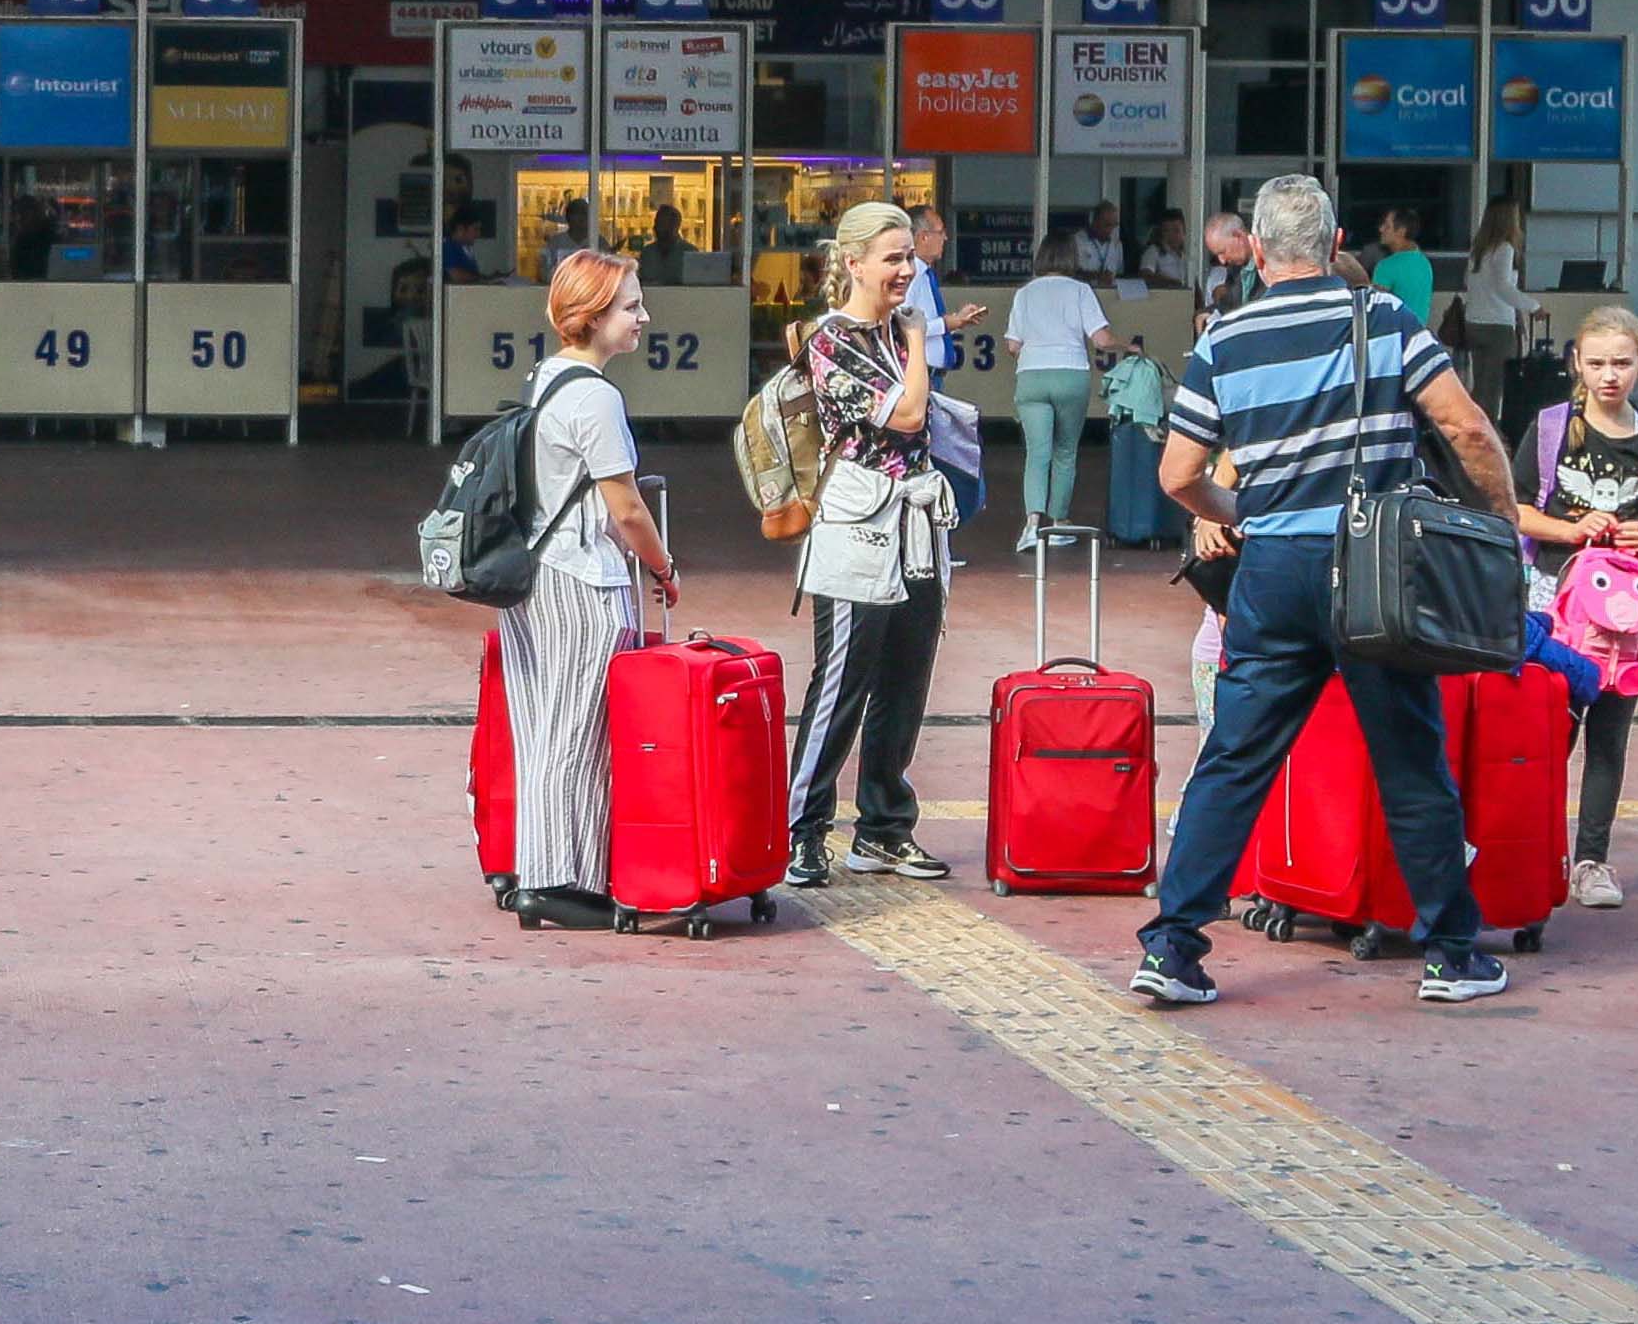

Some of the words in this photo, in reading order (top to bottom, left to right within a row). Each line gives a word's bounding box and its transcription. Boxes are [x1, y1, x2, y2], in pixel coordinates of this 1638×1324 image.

[480, 41, 532, 55] vtours
[34, 78, 119, 94] Intourist
[917, 67, 1019, 92] easyJet
[1074, 67, 1168, 83] TOURISTIK
[917, 91, 1019, 114] holidays
[1397, 84, 1467, 107] Coral
[1545, 86, 1615, 109] Coral
[1110, 101, 1167, 119] Coral
[471, 121, 563, 139] novanta
[627, 124, 719, 142] novanta
[981, 240, 1012, 256] SIM
[35, 329, 91, 369] 49
[191, 329, 247, 369] 50
[492, 332, 546, 370] 51
[648, 332, 700, 371] 52
